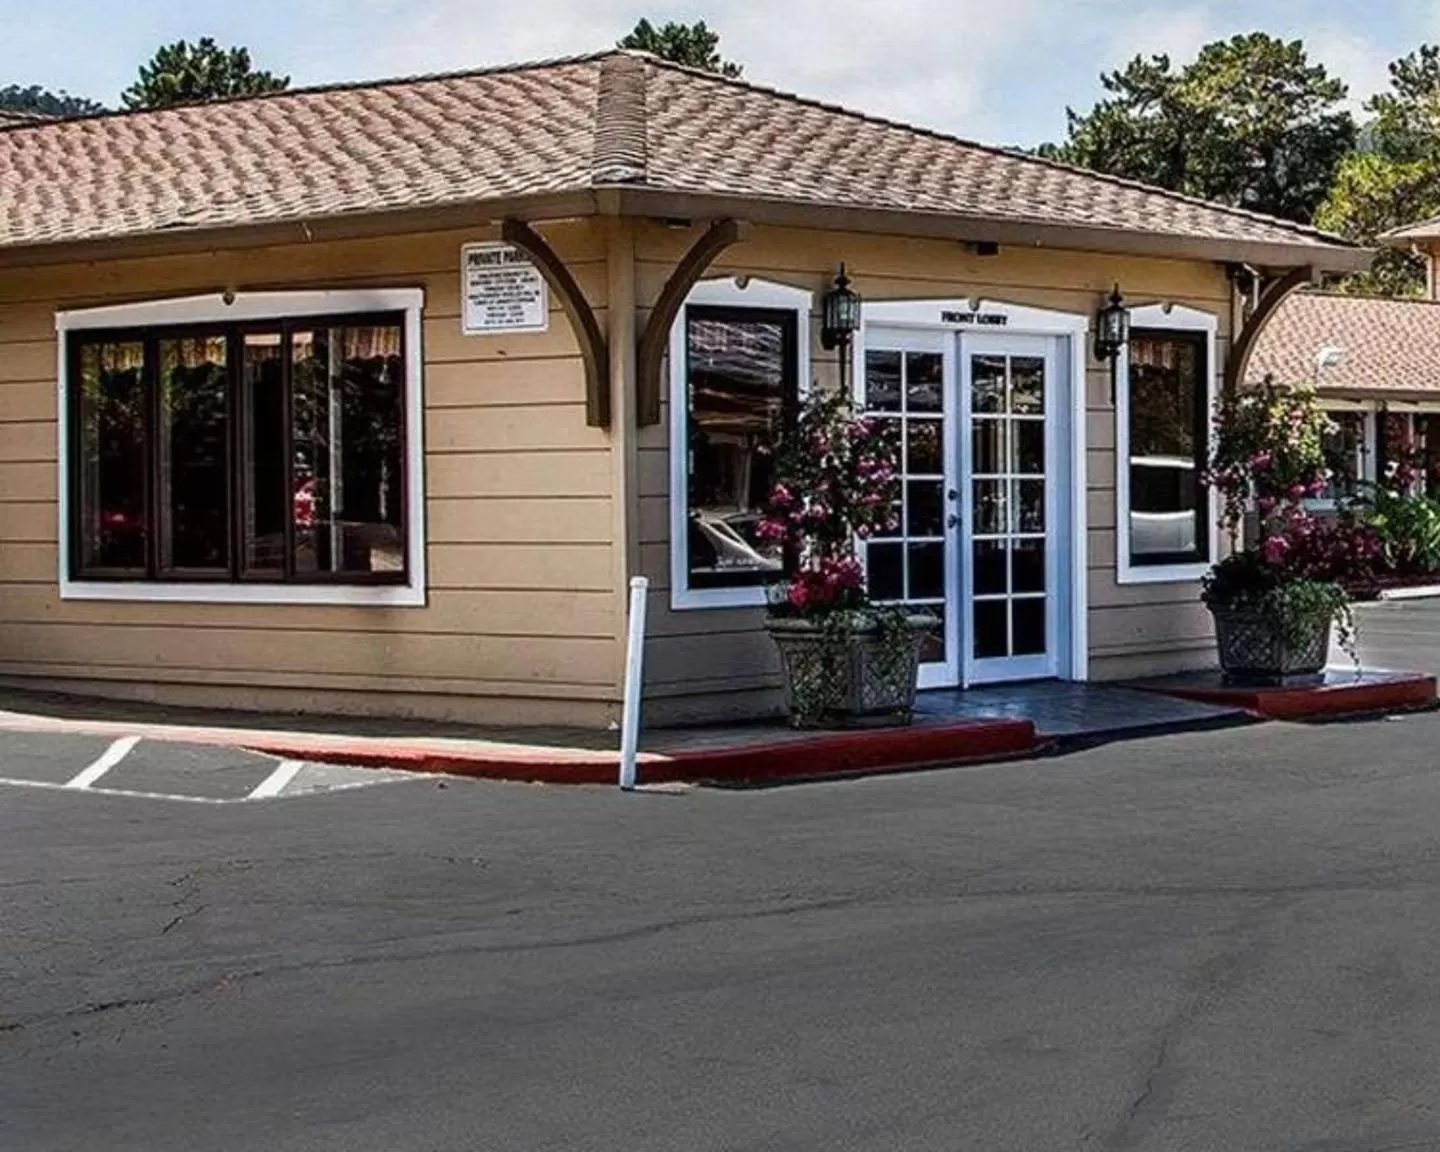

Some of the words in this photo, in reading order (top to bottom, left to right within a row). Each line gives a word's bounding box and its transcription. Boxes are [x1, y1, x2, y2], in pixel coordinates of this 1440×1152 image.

[468, 251, 502, 264] PRIVATE
[942, 311, 975, 324] FRONT
[976, 314, 1008, 325] LOBBY
